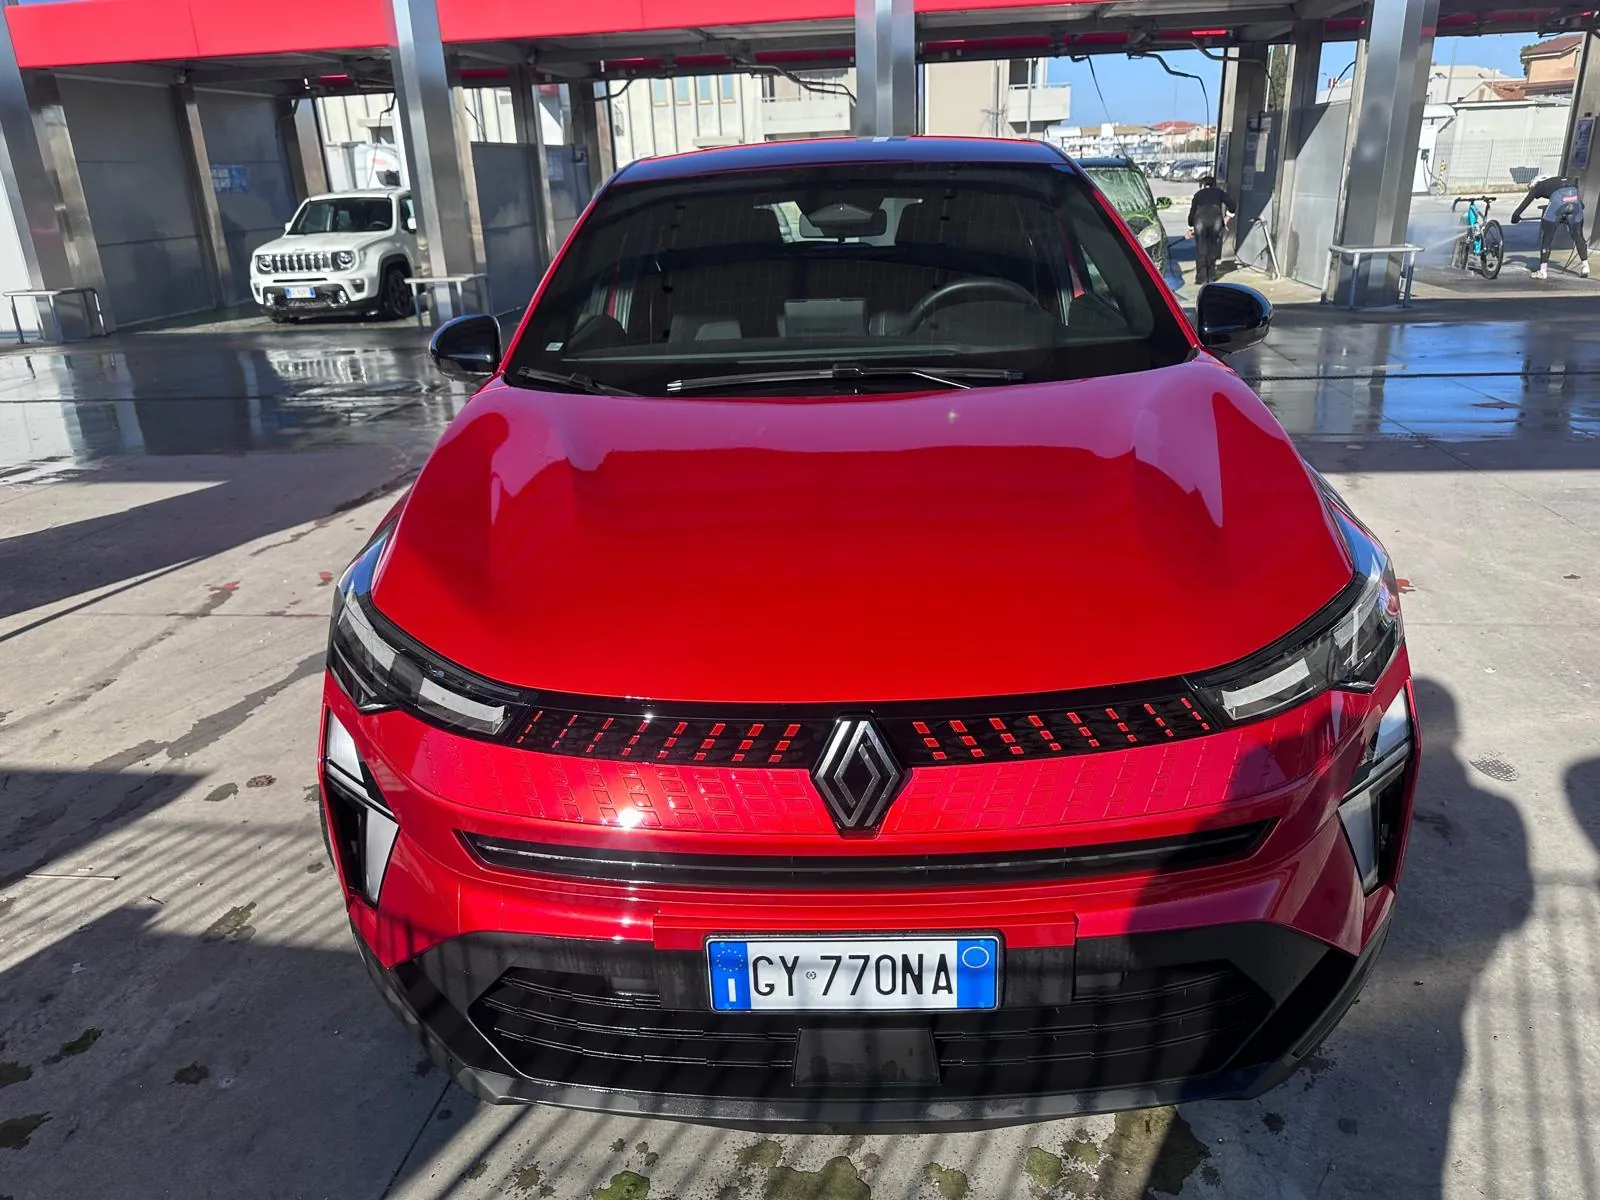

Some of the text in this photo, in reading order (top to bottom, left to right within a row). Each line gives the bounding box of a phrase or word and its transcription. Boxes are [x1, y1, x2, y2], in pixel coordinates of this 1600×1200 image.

[727, 978, 737, 1002] I
[752, 953, 954, 997] GY 770NA
